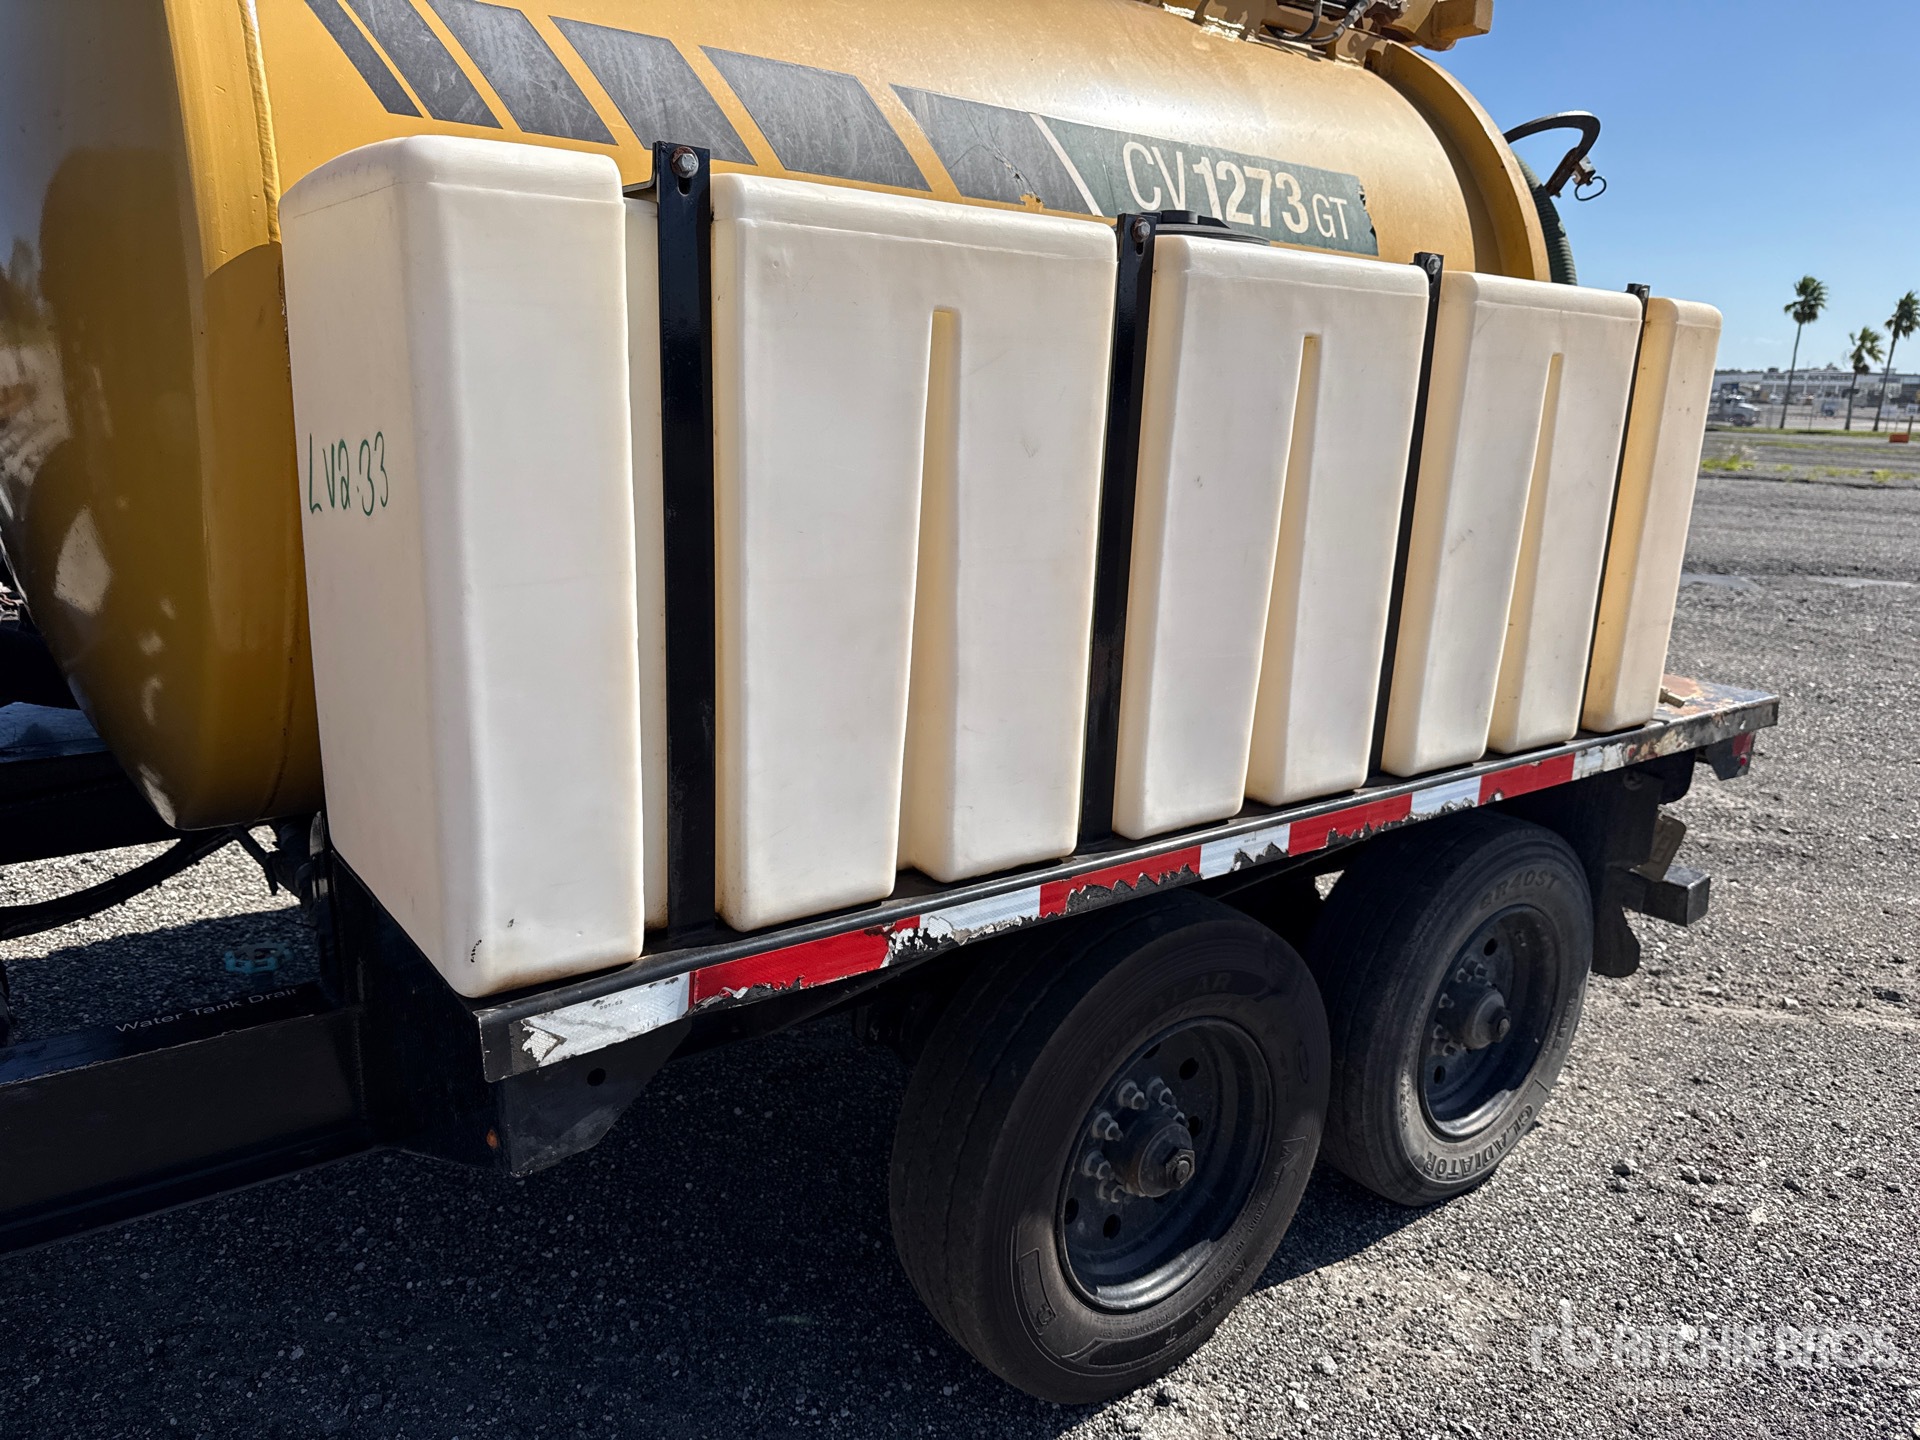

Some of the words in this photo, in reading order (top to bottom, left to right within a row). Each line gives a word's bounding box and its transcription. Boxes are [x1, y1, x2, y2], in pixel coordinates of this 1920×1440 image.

[114, 1012, 184, 1033] Water
[189, 1000, 243, 1017] Tank
[1422, 1104, 1534, 1179] GLADIATOR
